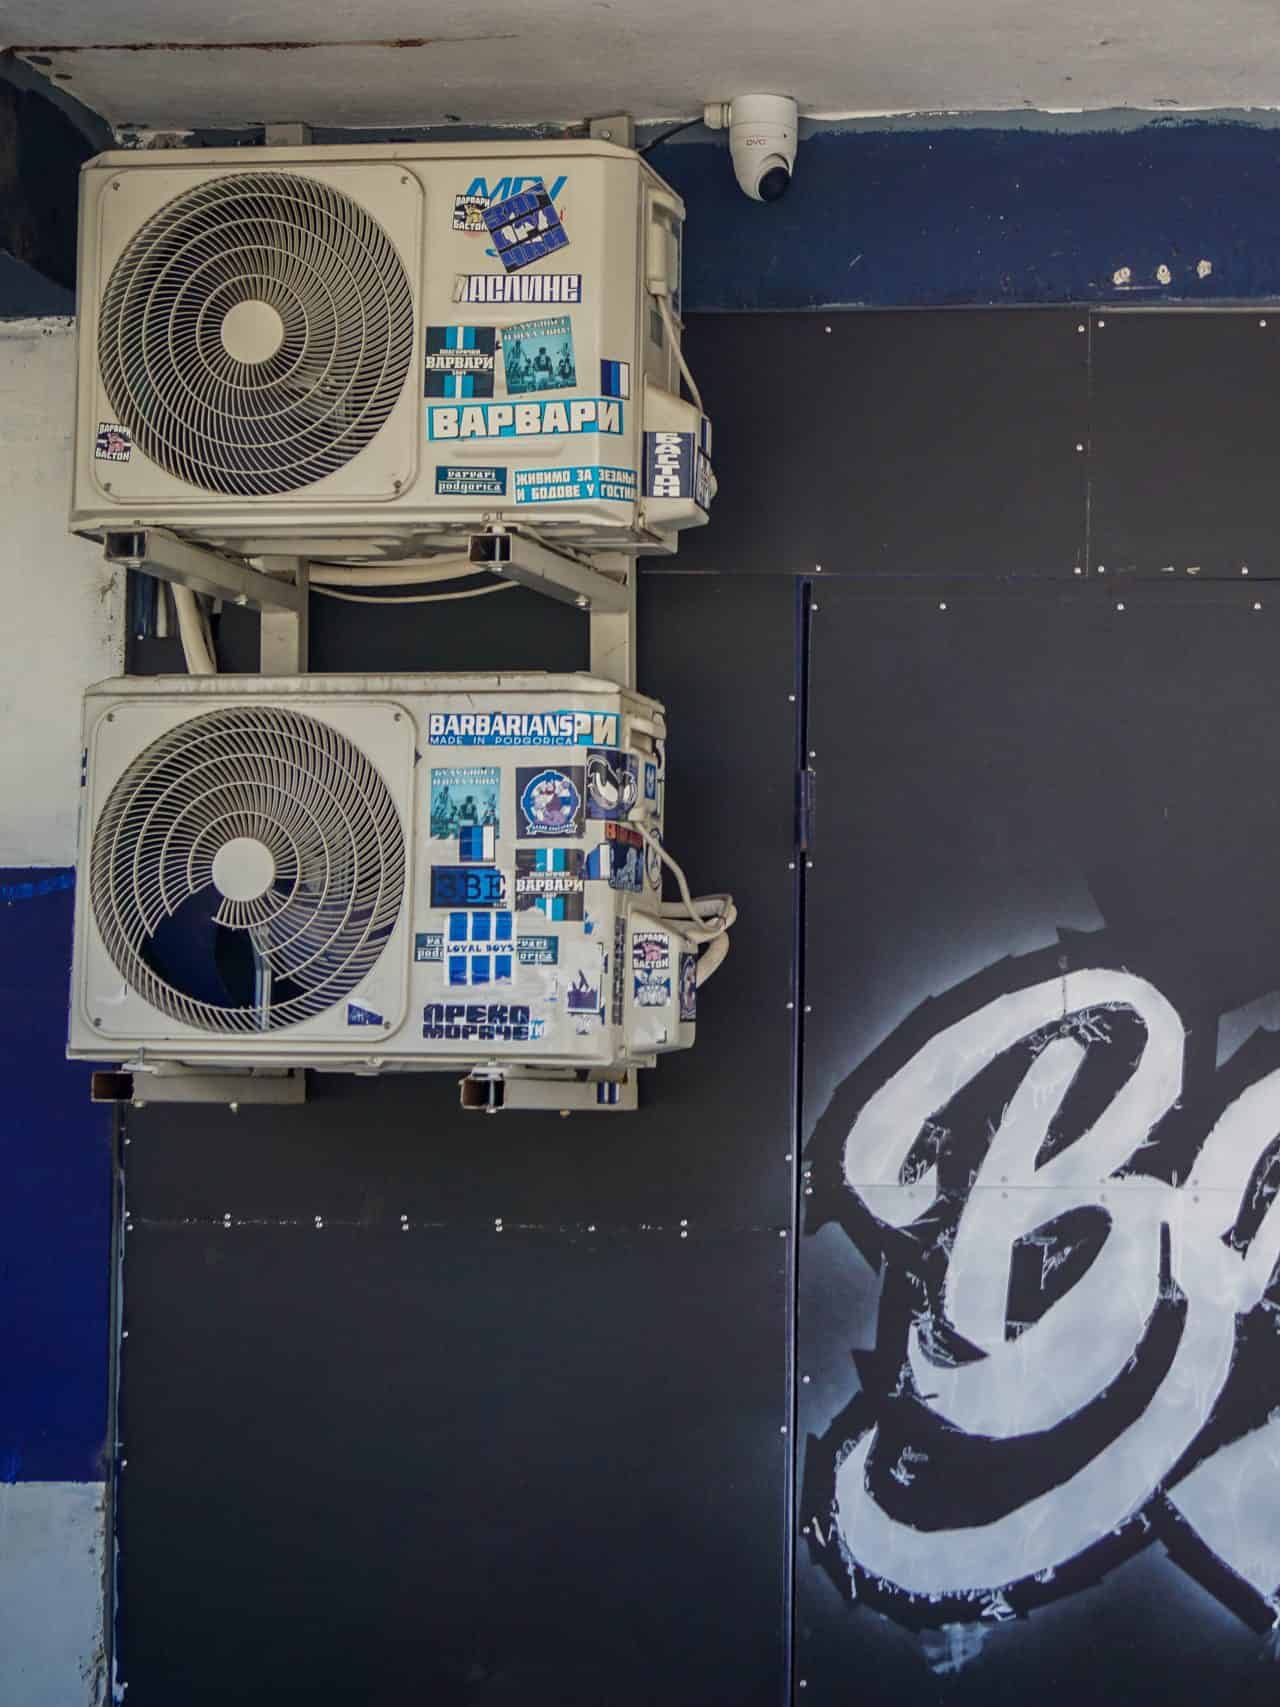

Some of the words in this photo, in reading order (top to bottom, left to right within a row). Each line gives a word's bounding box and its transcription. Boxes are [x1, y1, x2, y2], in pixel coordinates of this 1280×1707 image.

[426, 356, 493, 369] ВАРВАРИ
[432, 400, 621, 438] ВАРВАРИ
[447, 469, 496, 480] varvari
[516, 470, 570, 486] ЖИВИМО
[577, 468, 592, 482] ЗА
[438, 480, 502, 494] podgorica
[517, 487, 525, 501] И
[532, 484, 580, 500] БОДОВЕ
[587, 483, 595, 497] У
[430, 713, 574, 736] BARBARIANS
[430, 737, 463, 745] MADE
[473, 736, 486, 745] IN
[495, 736, 573, 745] PODGORICA
[516, 879, 584, 892] ВАРВАРИ
[447, 943, 482, 953] LOYAL
[486, 943, 515, 952] BOYS
